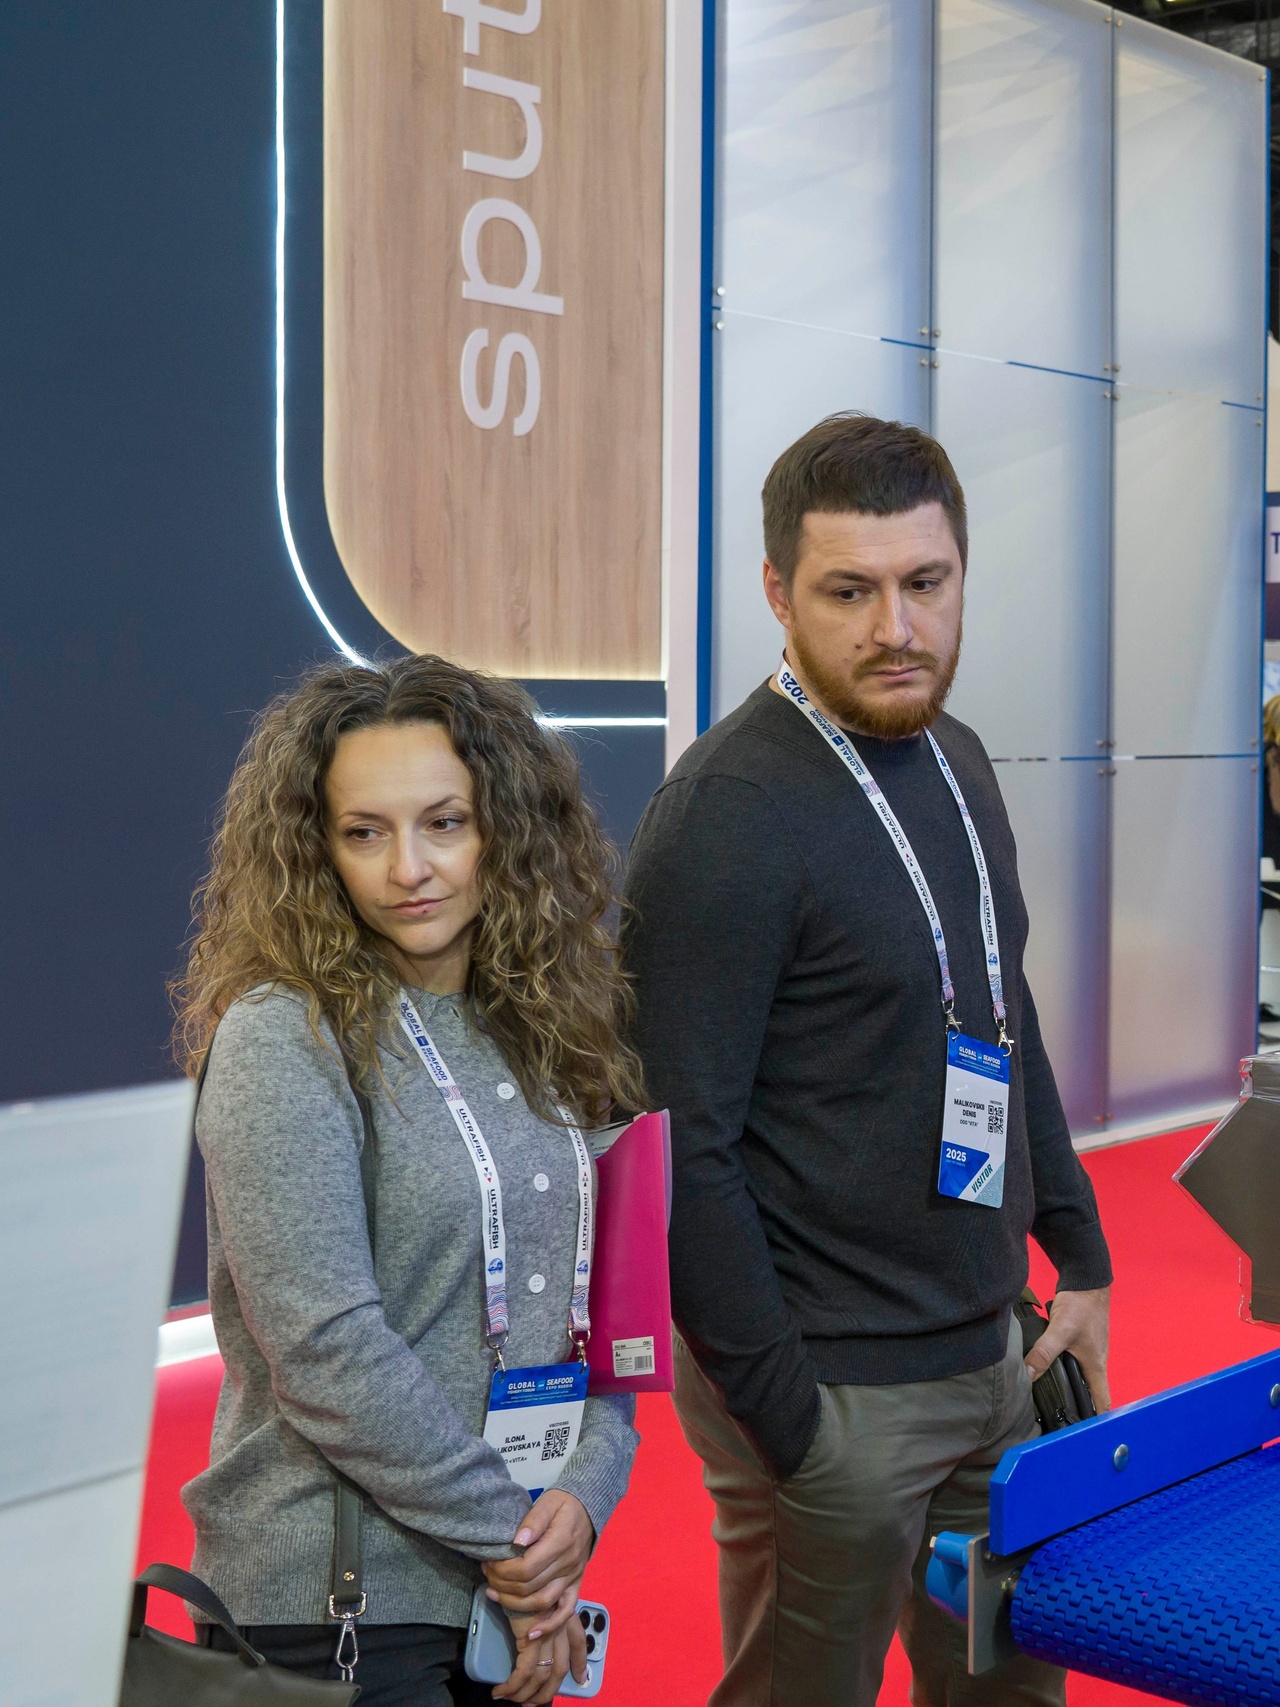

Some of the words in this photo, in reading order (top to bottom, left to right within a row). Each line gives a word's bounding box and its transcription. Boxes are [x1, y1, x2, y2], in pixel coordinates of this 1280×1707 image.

[781, 672, 809, 704] 2025
[809, 710, 834, 737] SEAFOOD
[840, 745, 862, 776] GLOBAL
[877, 802, 905, 849] ULTRAFISH
[968, 824, 985, 872] ULTRAFISH
[913, 871, 935, 920] ULTRAFISH
[985, 895, 994, 945] ULTRAFISH
[401, 1002, 423, 1034] GLOBAL
[426, 1047, 448, 1081] SEAFOOD
[959, 1046, 977, 1057] GLOBAL
[962, 1109, 977, 1118] DENIS
[459, 1108, 487, 1162] ULTRAFISH
[946, 1147, 967, 1162] 2025
[971, 1163, 994, 1193] VISITOR
[490, 1189, 499, 1249] ULTRAFISH
[508, 1381, 536, 1390] GLOBAL
[546, 1376, 574, 1386] SEAFOOD
[495, 1440, 541, 1453] LIKOVSKAYA
[505, 1434, 526, 1444] ILONA
